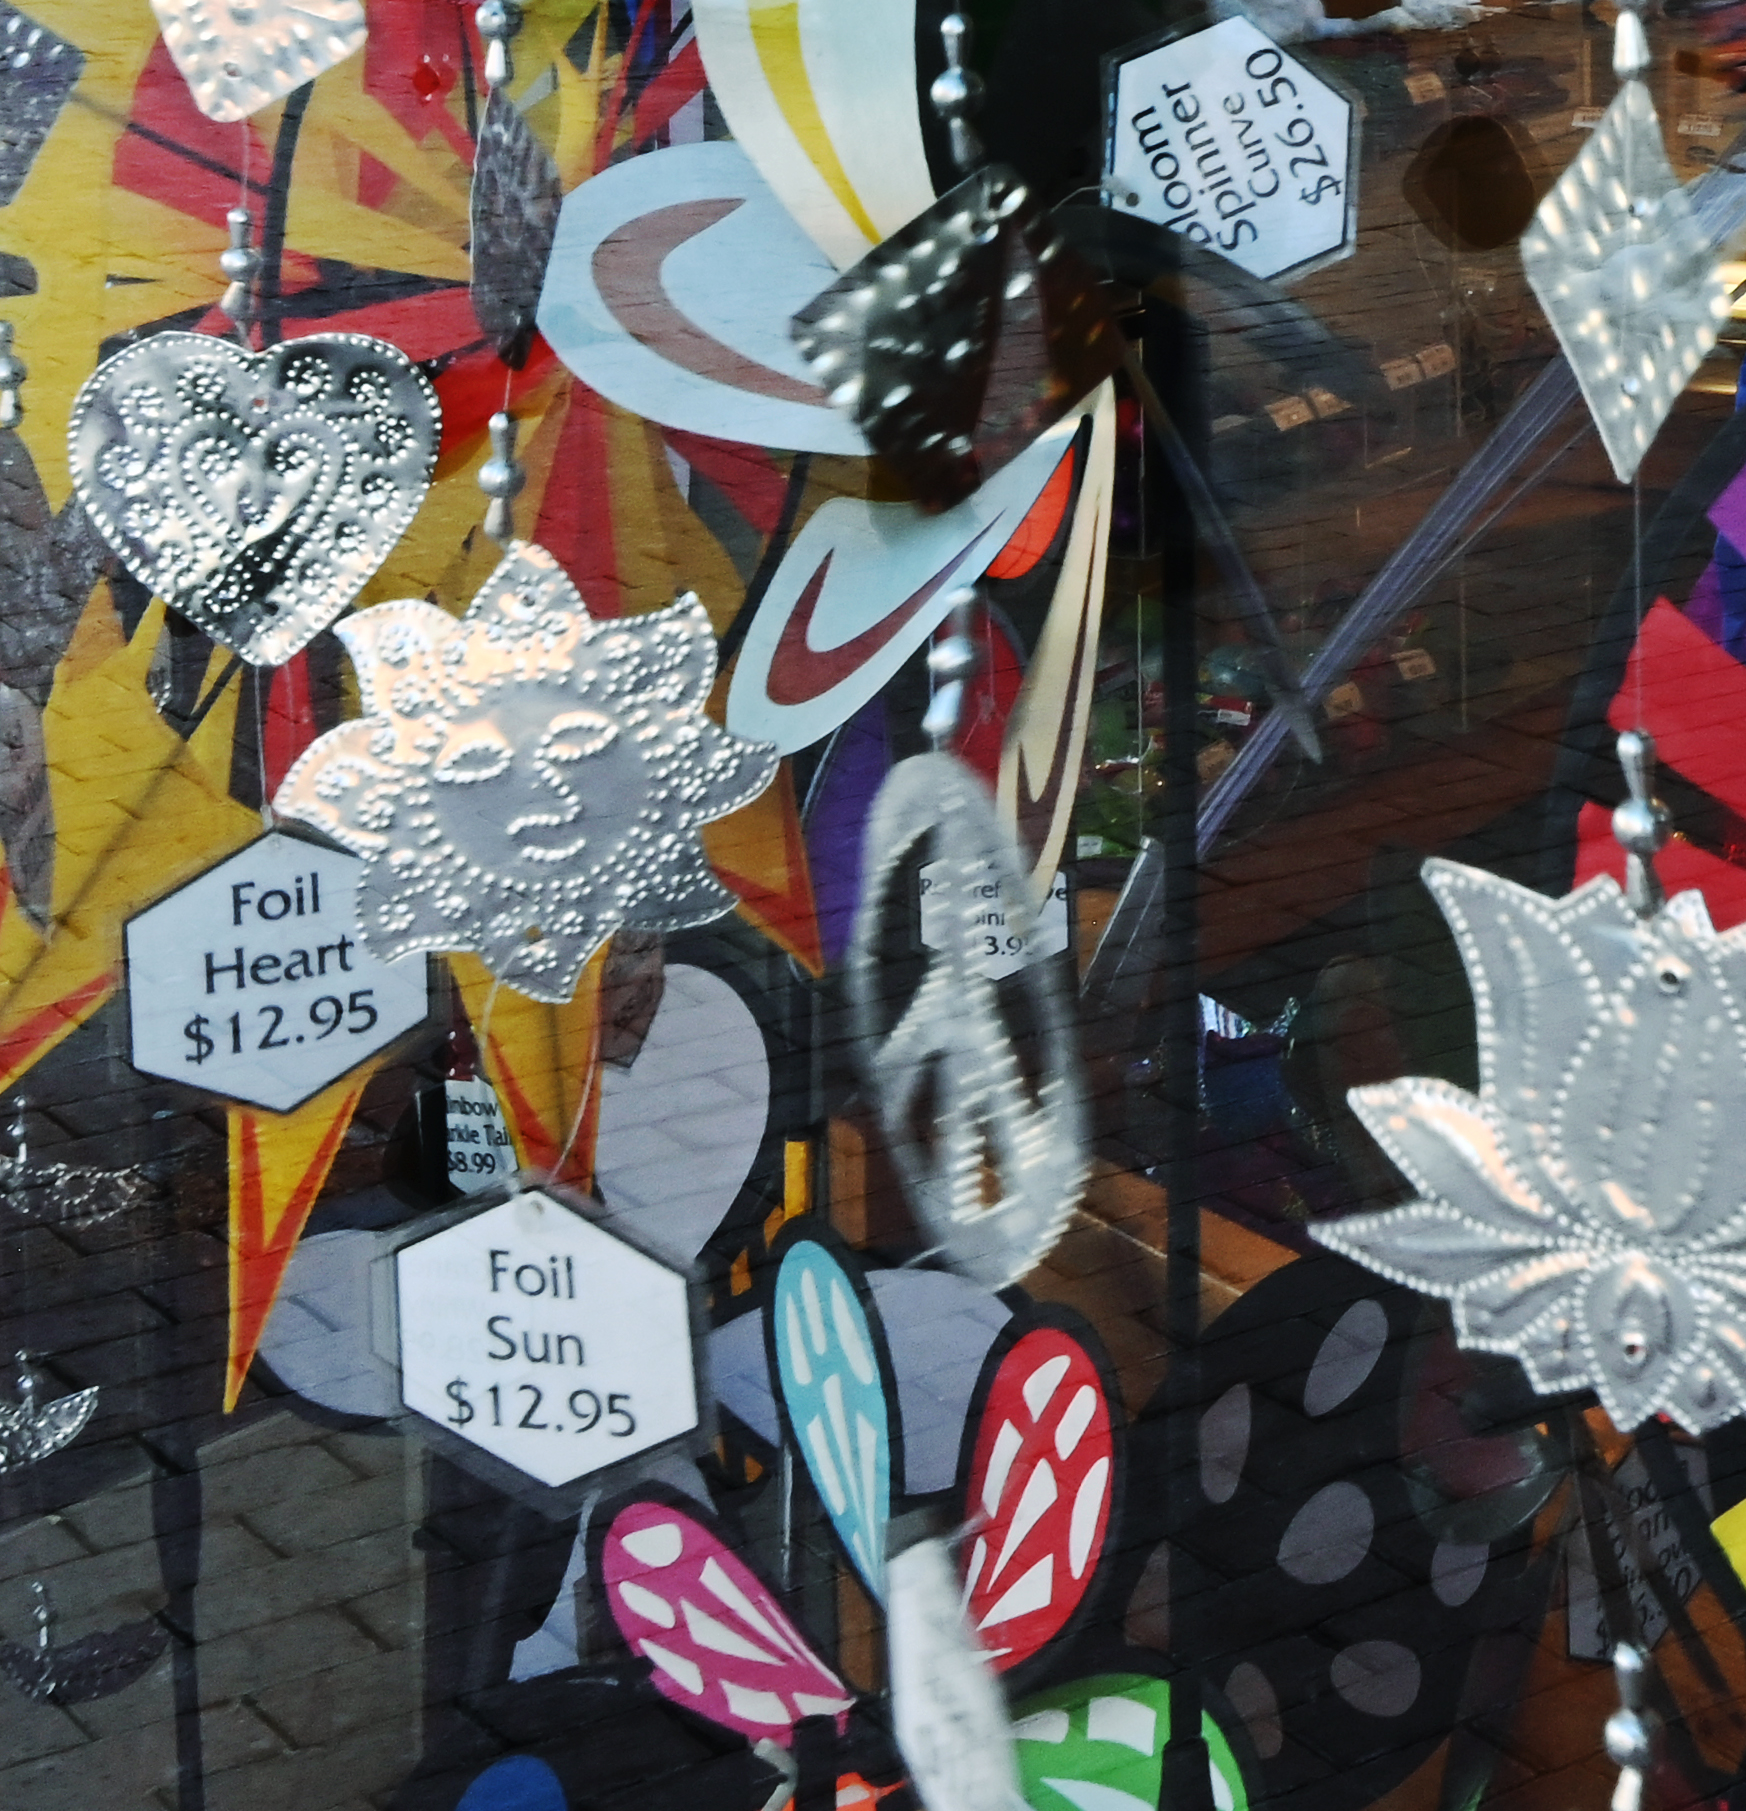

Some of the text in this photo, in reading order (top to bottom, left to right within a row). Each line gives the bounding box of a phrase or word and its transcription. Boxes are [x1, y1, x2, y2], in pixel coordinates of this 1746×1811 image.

[1223, 92, 1280, 198] Curve
[1245, 48, 1342, 205] $26.50
[1162, 82, 1258, 251] Spinner
[231, 871, 320, 926] Foil
[204, 934, 355, 995] Heart
[183, 989, 378, 1065] $12.95
[488, 1249, 576, 1300] Foil
[487, 1315, 585, 1367] Sun
[445, 1375, 637, 1439] $12.95
